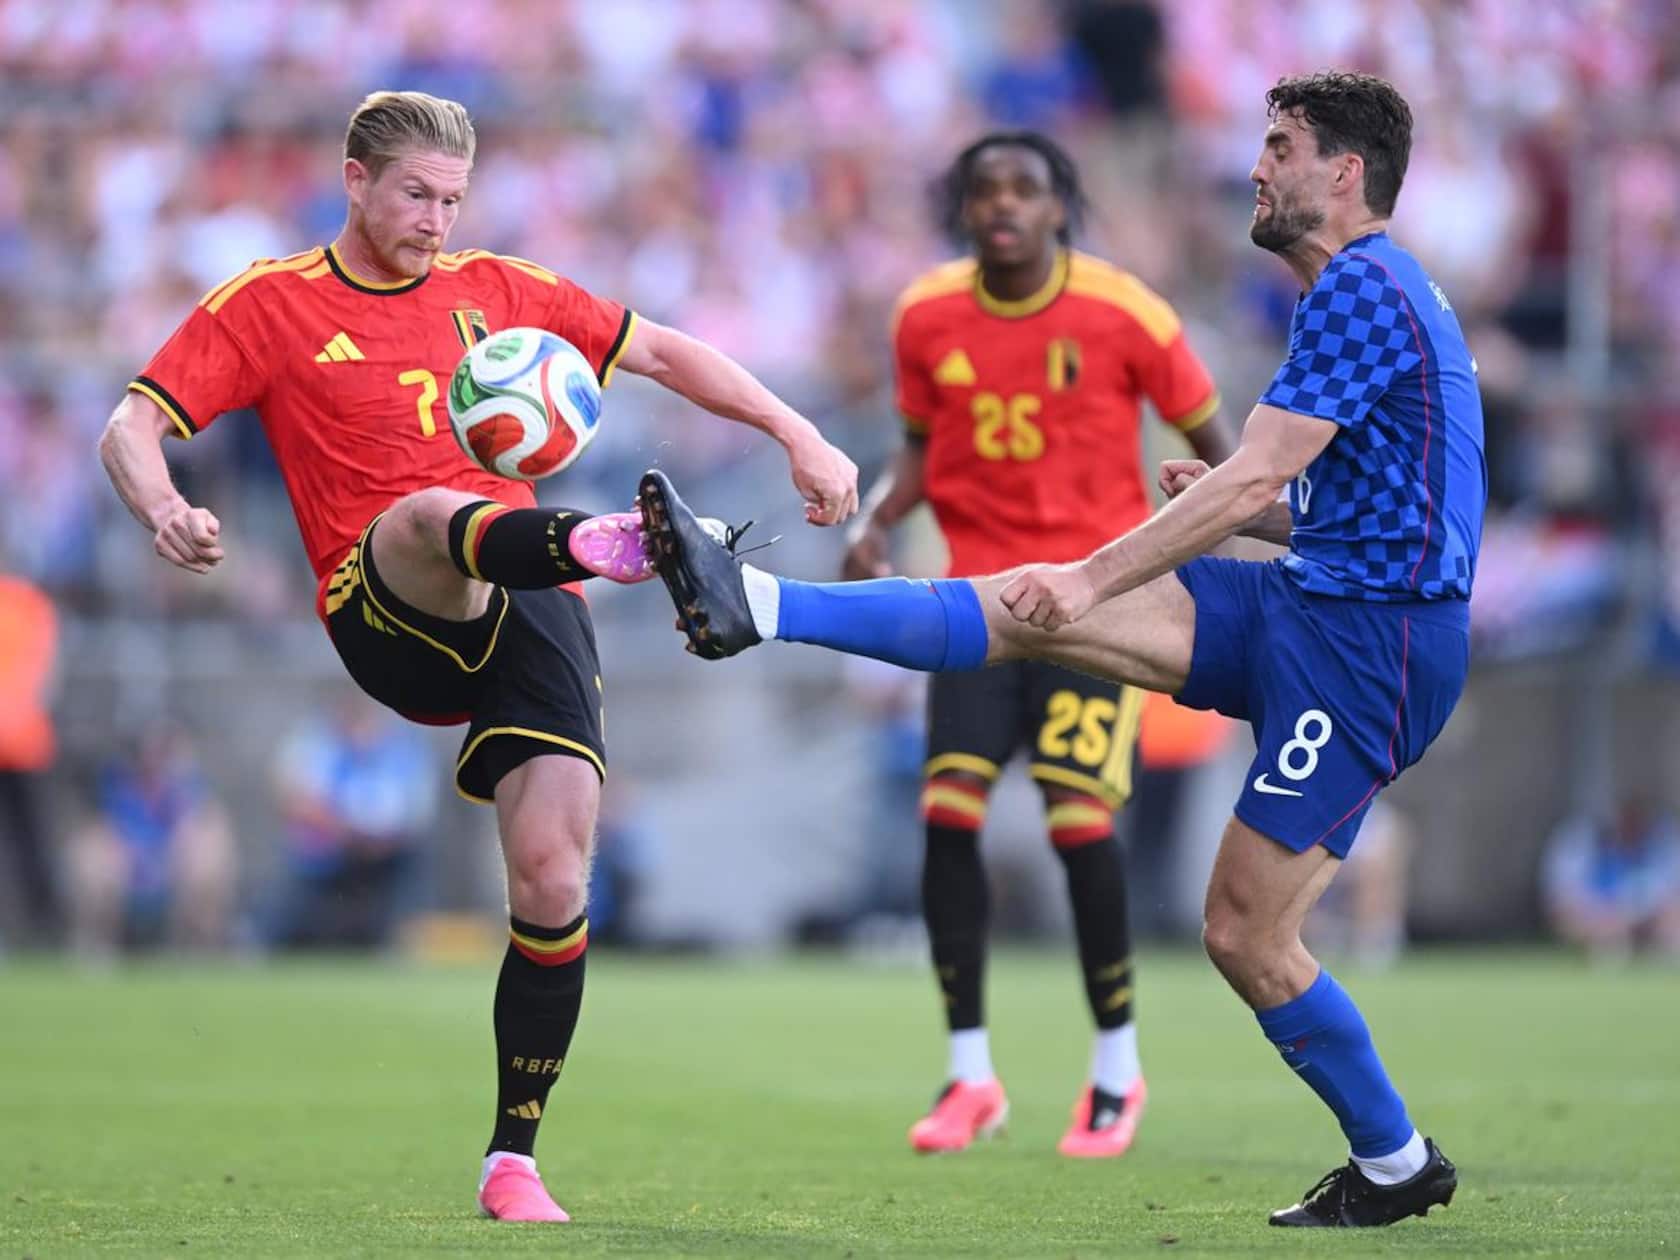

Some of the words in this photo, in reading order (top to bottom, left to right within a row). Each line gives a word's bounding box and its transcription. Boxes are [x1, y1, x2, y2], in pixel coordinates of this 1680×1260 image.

[398, 369, 439, 437] 7
[971, 391, 1045, 461] 25
[1038, 688, 1117, 766] 25
[1278, 709, 1333, 781] 8
[512, 1055, 563, 1075] RBFA
